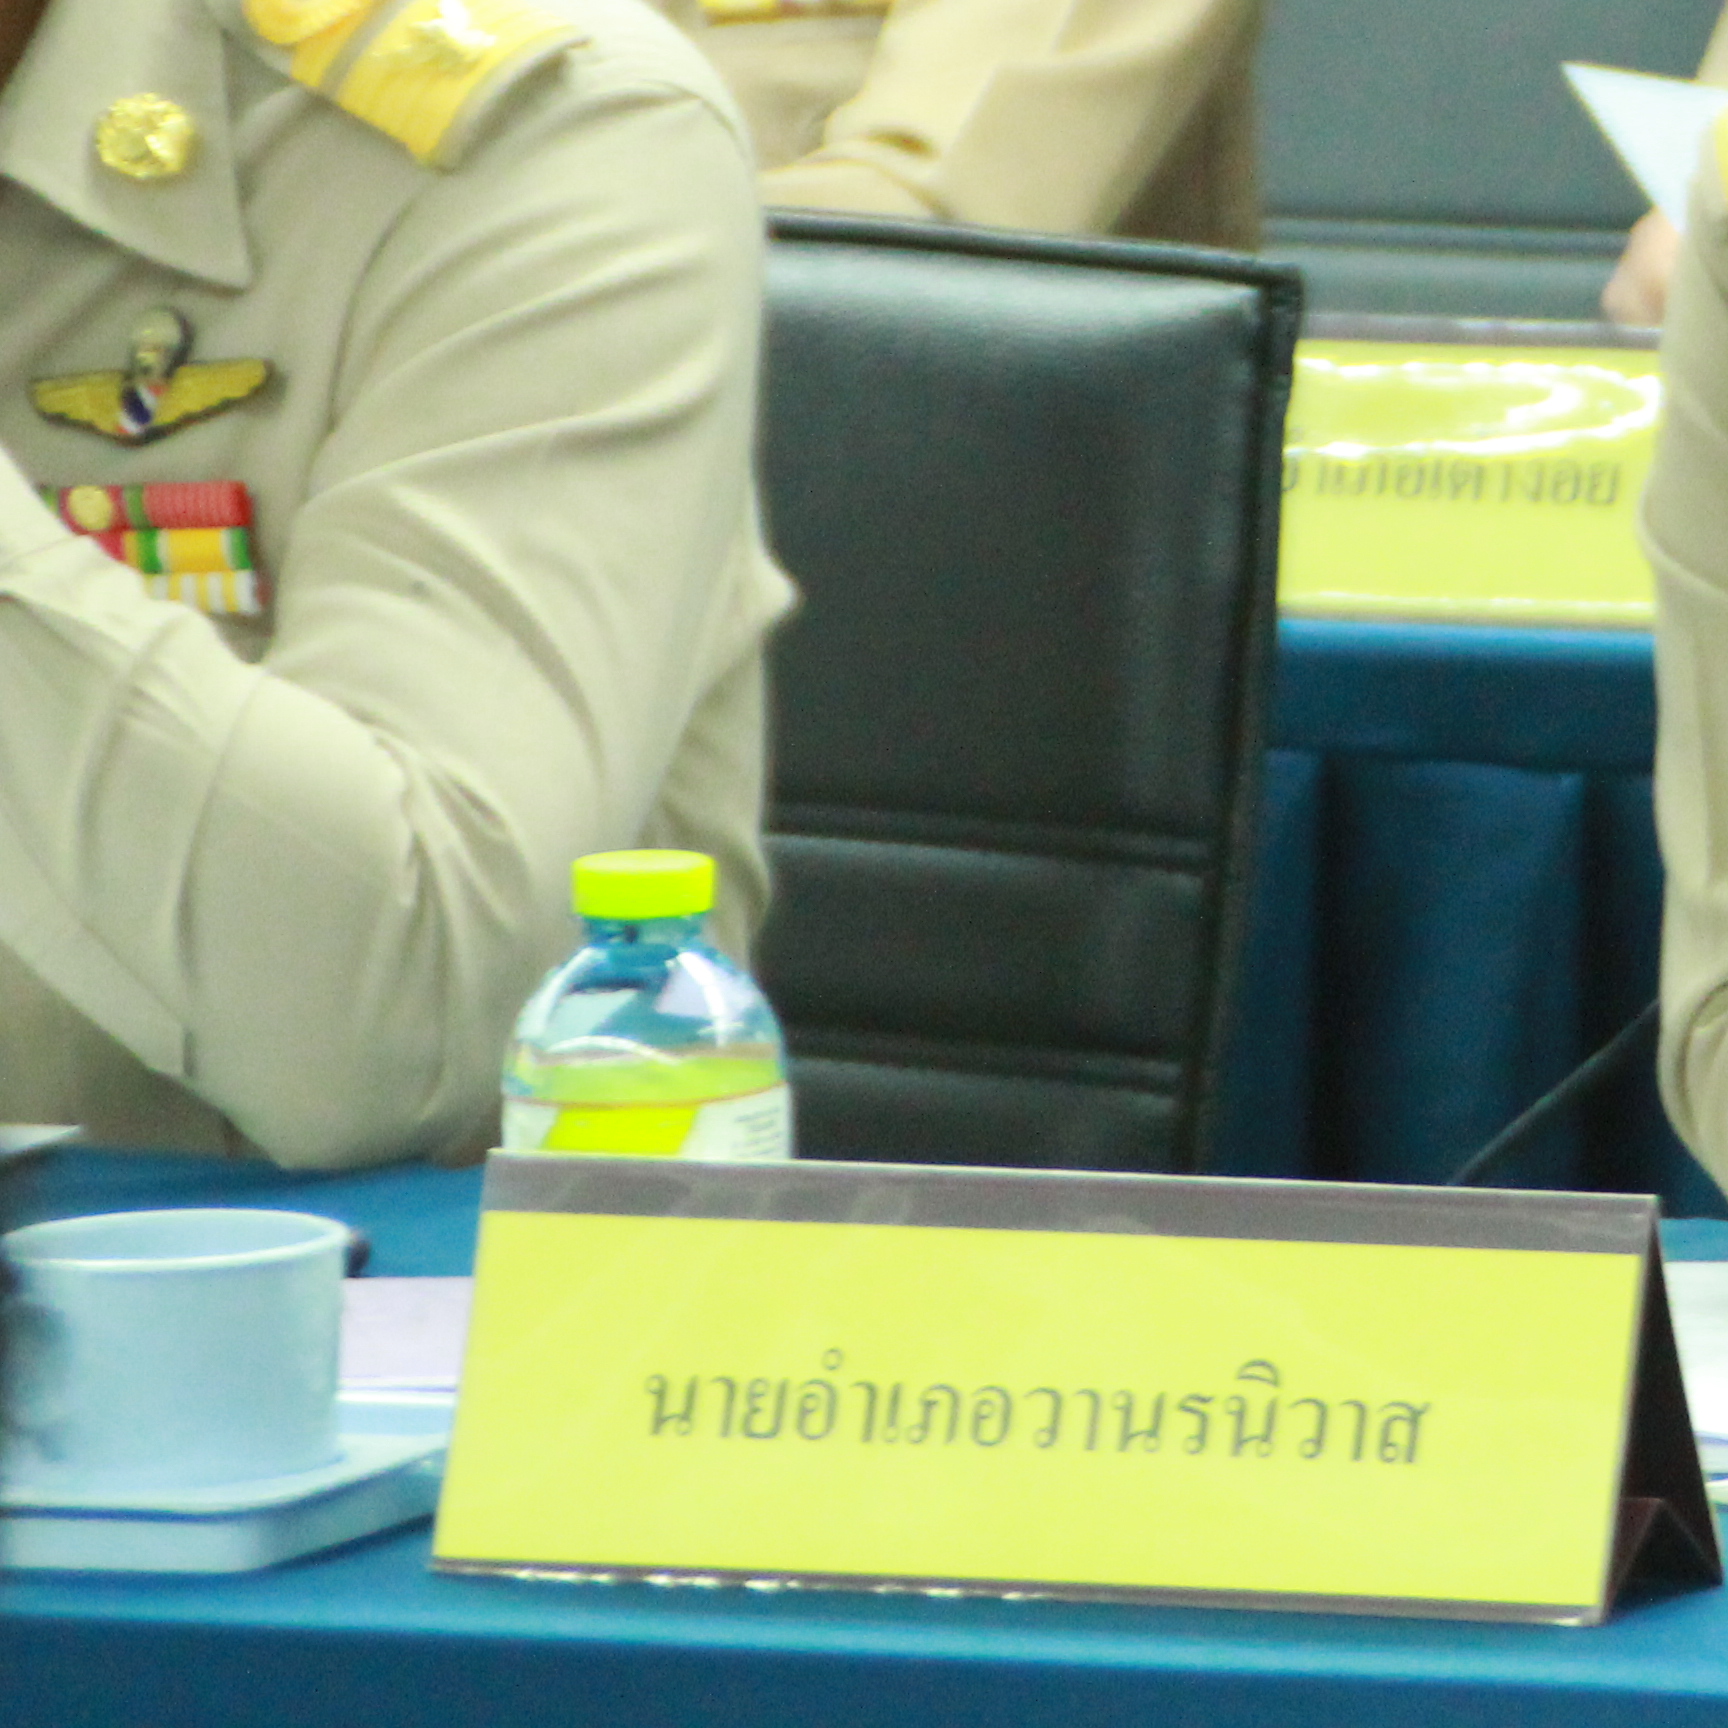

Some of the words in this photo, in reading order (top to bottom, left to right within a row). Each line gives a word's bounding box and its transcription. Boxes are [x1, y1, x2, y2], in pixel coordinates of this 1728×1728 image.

[644, 1347, 1432, 1465] นายอำเภอวานรนิวาส
